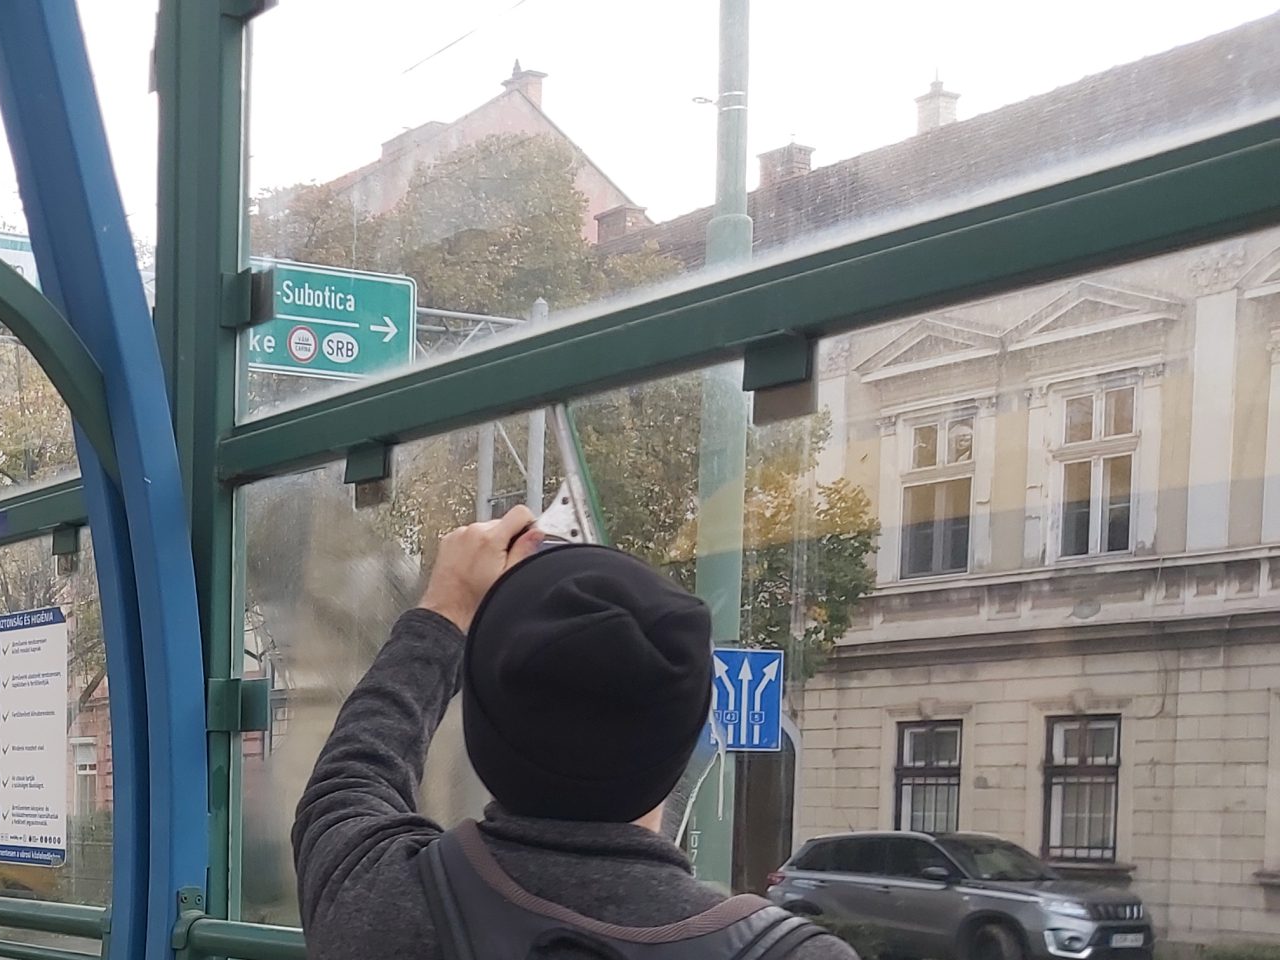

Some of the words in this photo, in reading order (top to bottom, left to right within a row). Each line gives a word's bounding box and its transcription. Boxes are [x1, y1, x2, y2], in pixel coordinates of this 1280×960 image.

[276, 280, 355, 312] -Subotica
[249, 329, 276, 353] ke
[326, 339, 355, 358] SRB
[24, 613, 30, 626] ÉS
[726, 713, 736, 721] 42
[754, 714, 760, 722] 5
